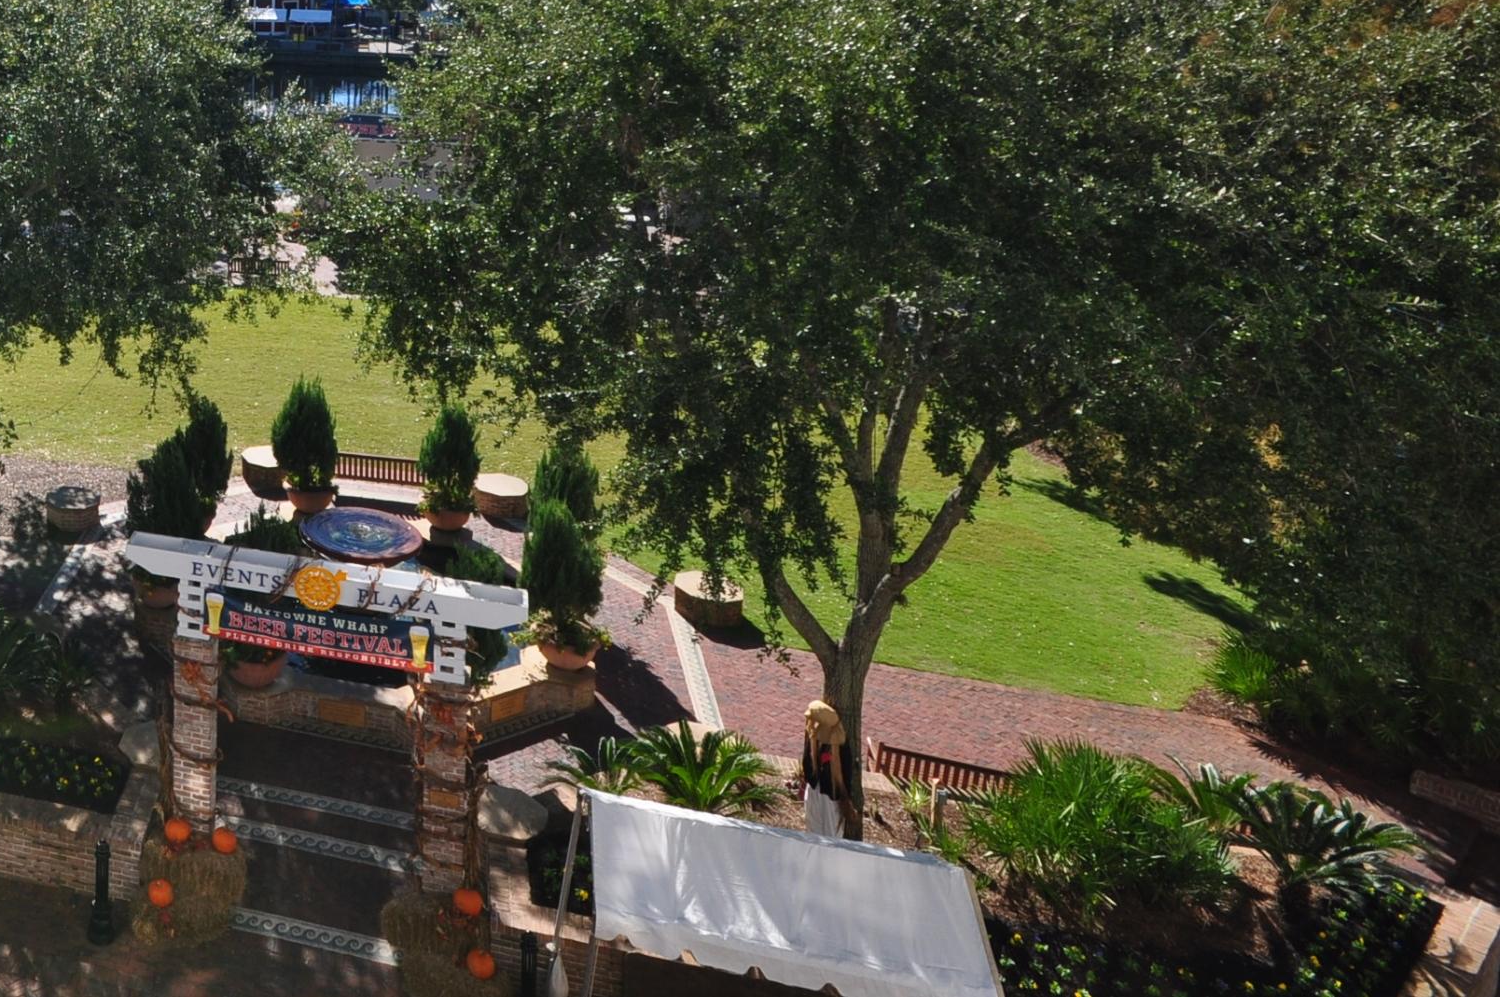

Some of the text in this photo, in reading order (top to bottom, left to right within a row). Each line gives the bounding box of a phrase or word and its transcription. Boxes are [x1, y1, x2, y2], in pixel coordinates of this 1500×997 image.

[192, 562, 439, 614] EVENTS PLAZA
[228, 611, 407, 656] BEER FESTIVAL
[244, 602, 388, 634] BAYTOWNE WHARF
[225, 631, 407, 667] PLEASE DRINK RESPONSIBLY
